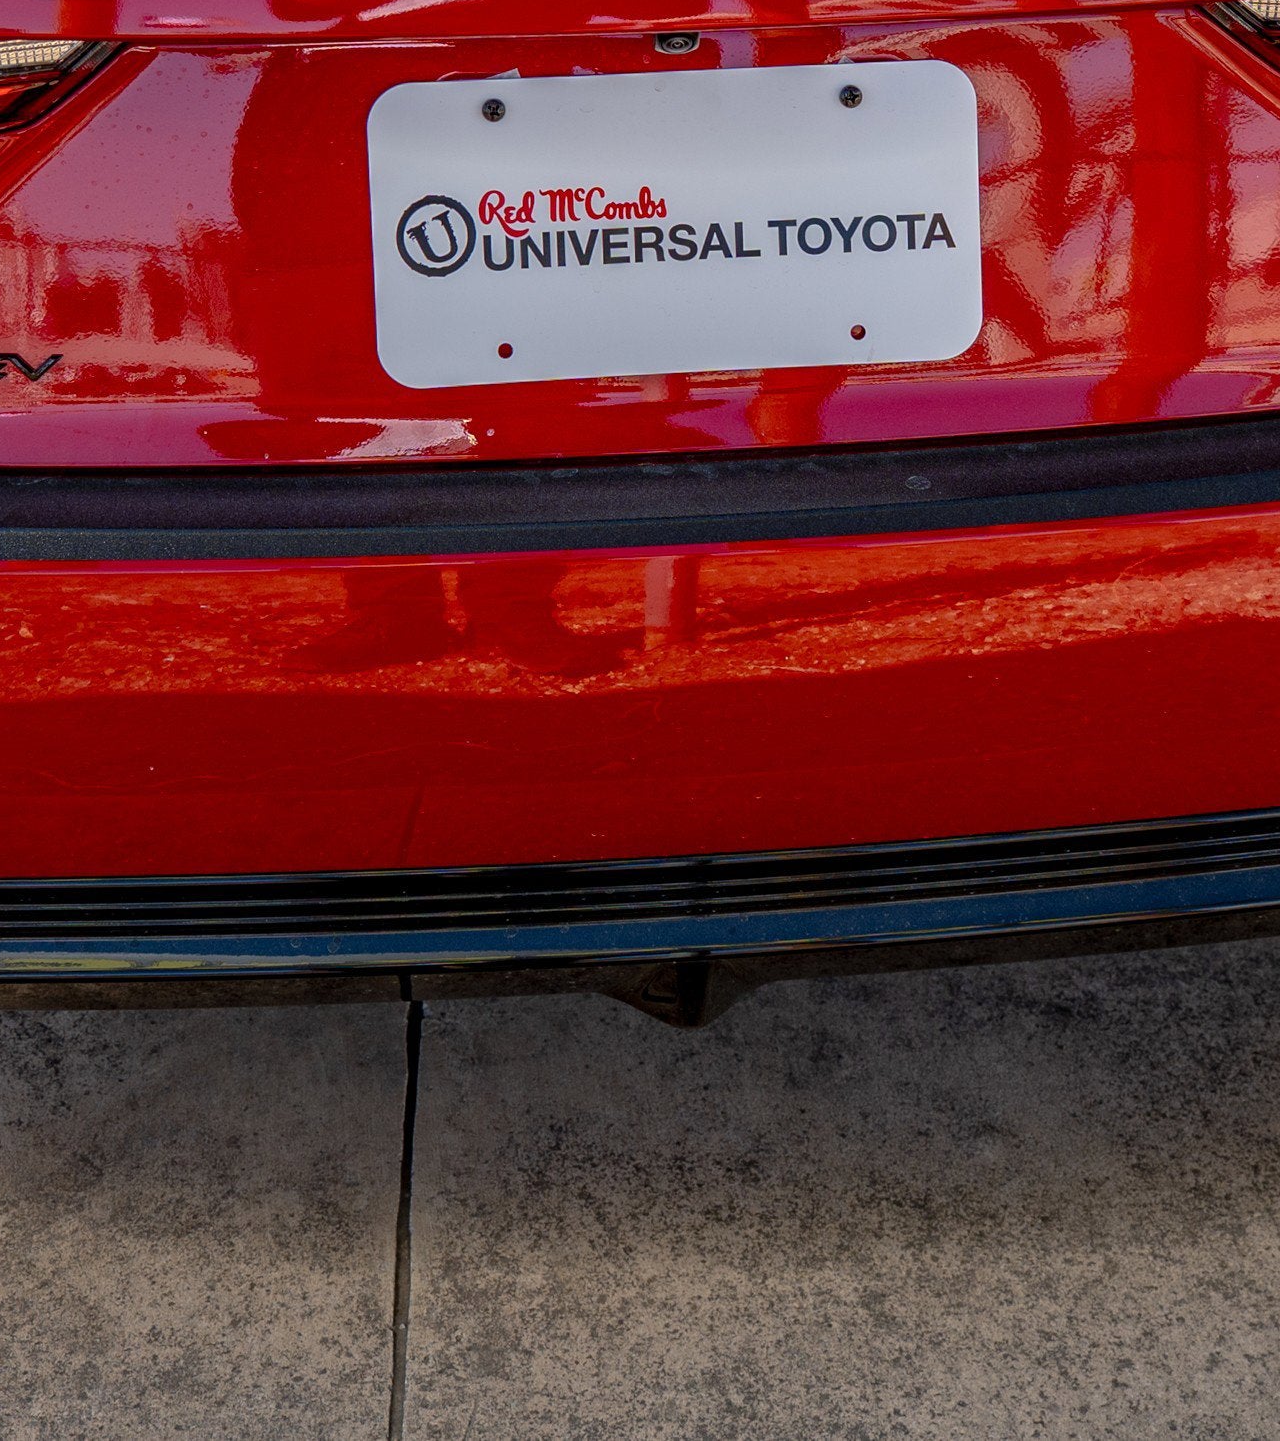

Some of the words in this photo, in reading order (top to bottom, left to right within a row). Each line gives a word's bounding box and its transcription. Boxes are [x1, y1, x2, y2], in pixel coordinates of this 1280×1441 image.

[478, 190, 536, 238] Red
[539, 186, 667, 223] McCombs
[482, 221, 761, 271] UNIVERSAL
[768, 213, 956, 257] TOYOTA
